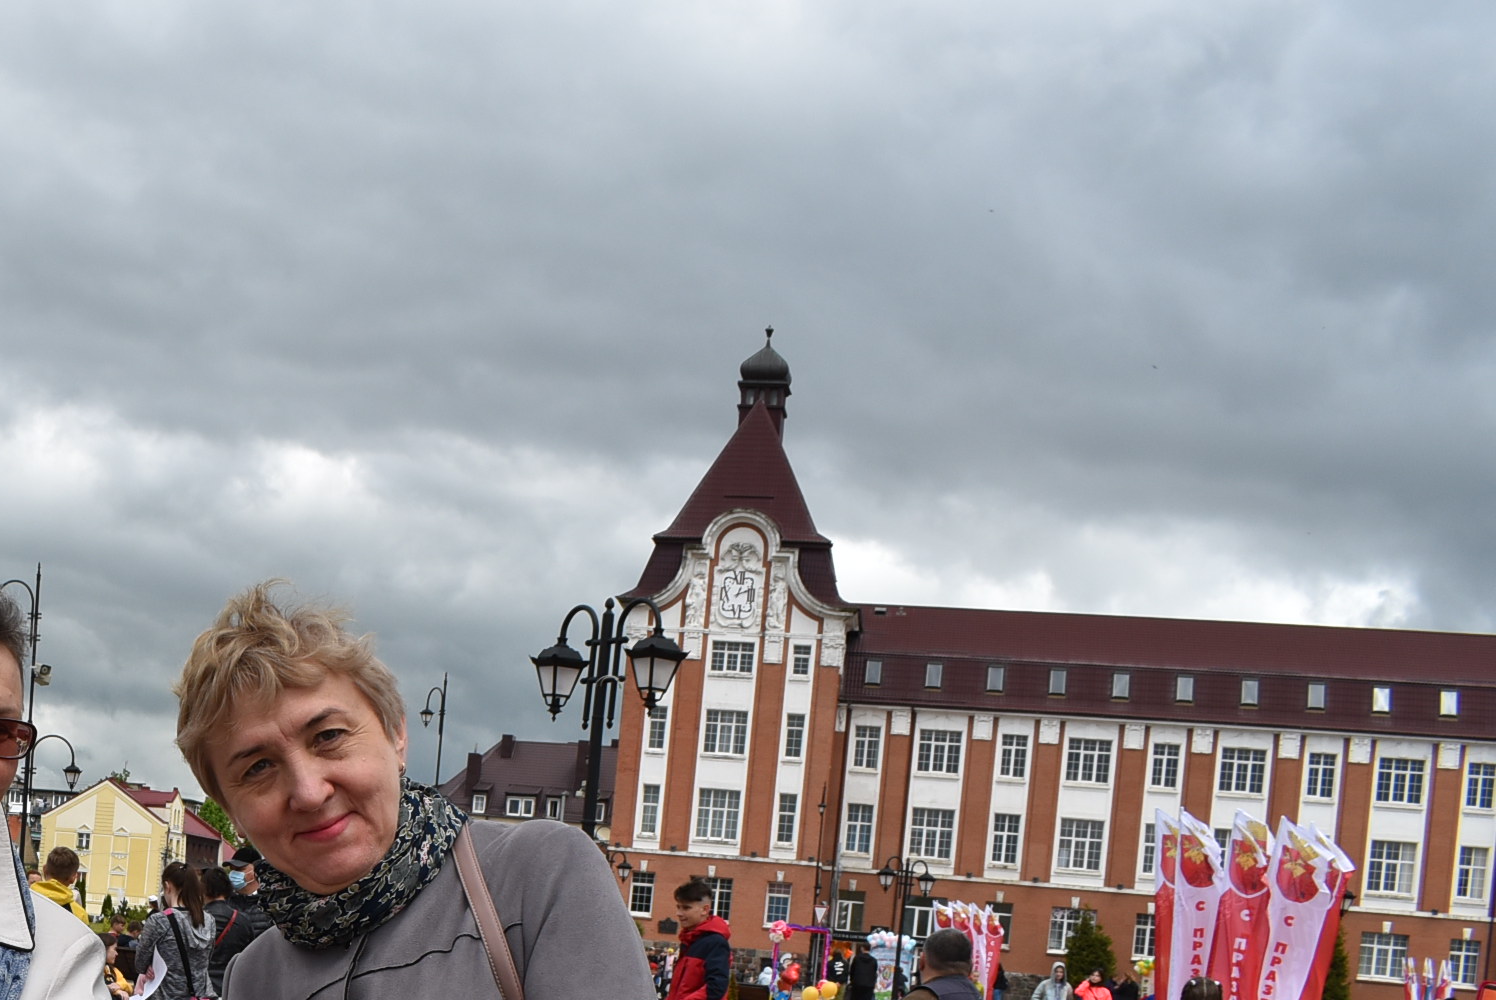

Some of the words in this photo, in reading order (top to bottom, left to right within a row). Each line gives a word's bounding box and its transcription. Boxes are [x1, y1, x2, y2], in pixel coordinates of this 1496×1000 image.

[1195, 901, 1206, 911] С
[1240, 909, 1251, 921] С
[1284, 916, 1295, 927] С
